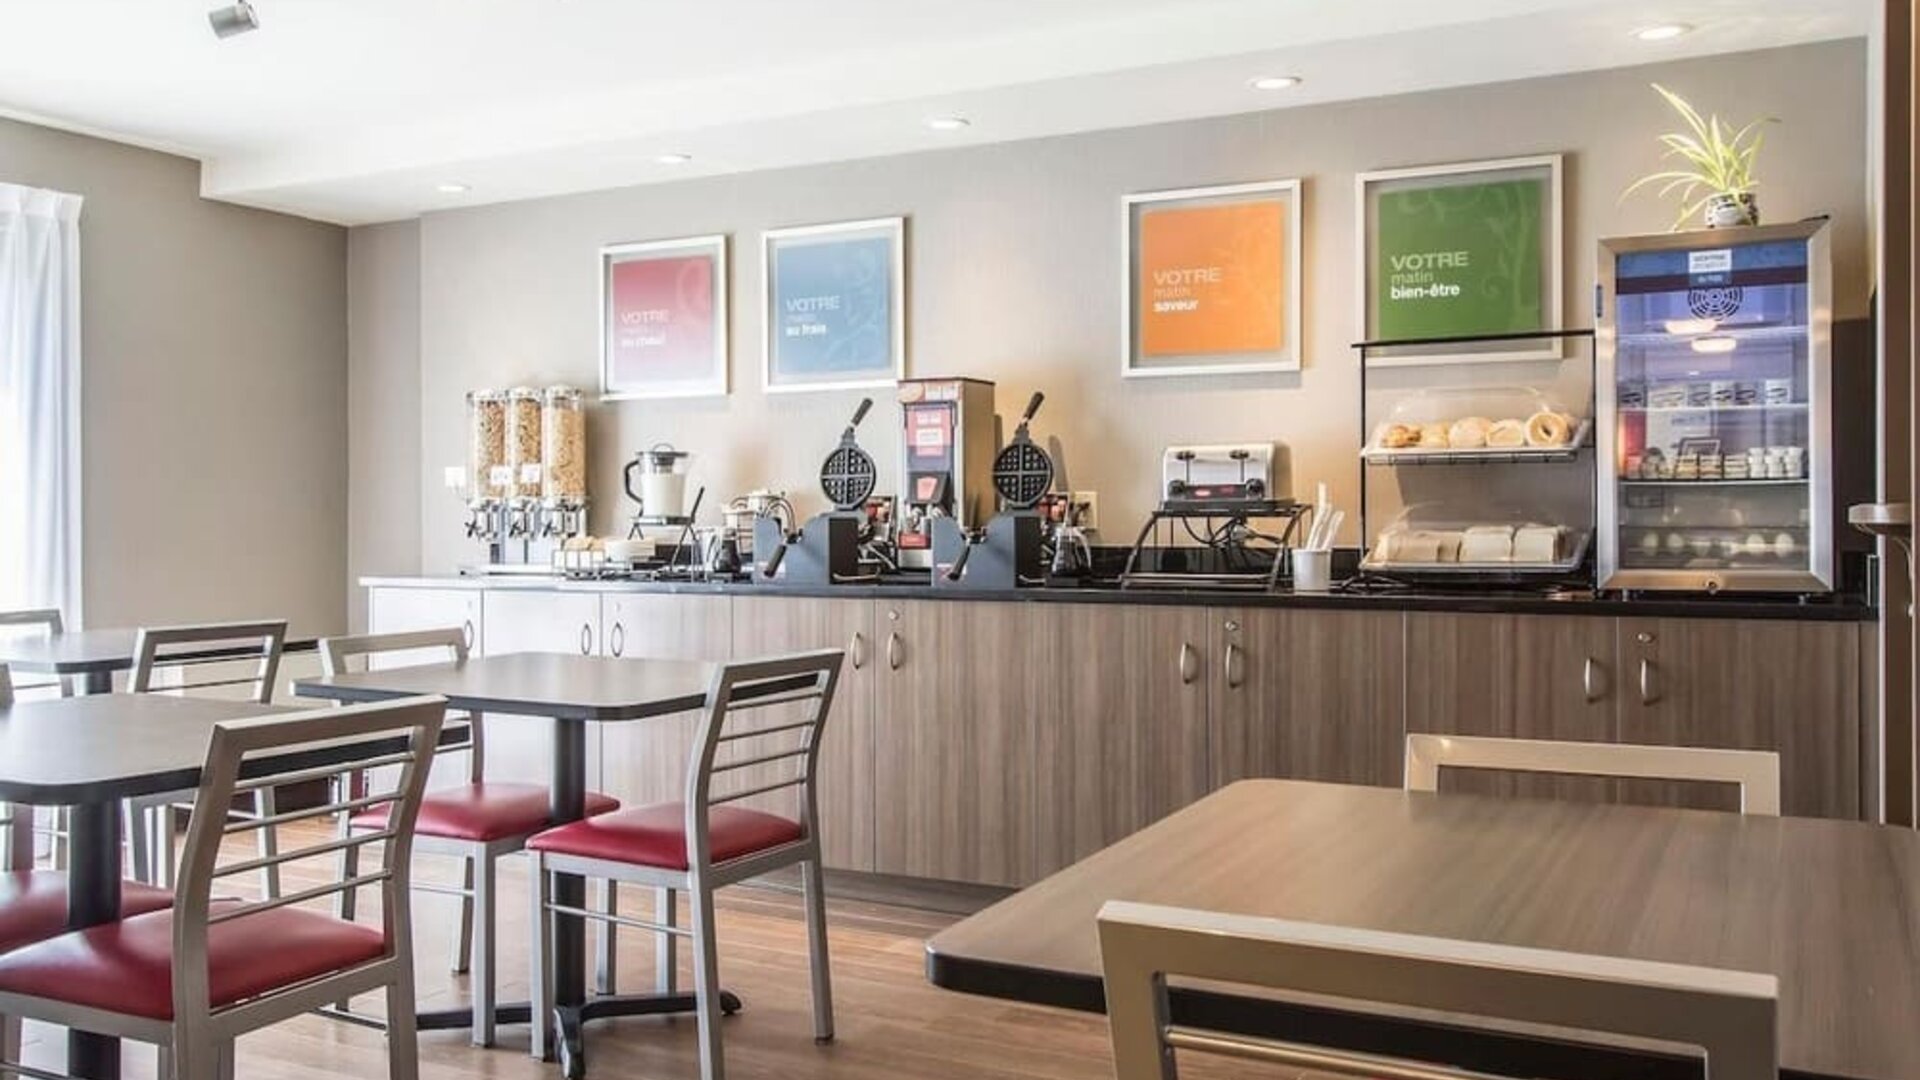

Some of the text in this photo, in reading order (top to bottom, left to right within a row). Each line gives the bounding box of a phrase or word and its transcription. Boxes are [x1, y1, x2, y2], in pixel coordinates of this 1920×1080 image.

[1391, 251, 1469, 271] VOTRE
[1152, 266, 1223, 286] VOTRE
[1391, 270, 1434, 285] matin
[1391, 283, 1460, 300] bien-être
[786, 295, 840, 312] VOTRE
[620, 309, 670, 325] VOTRE
